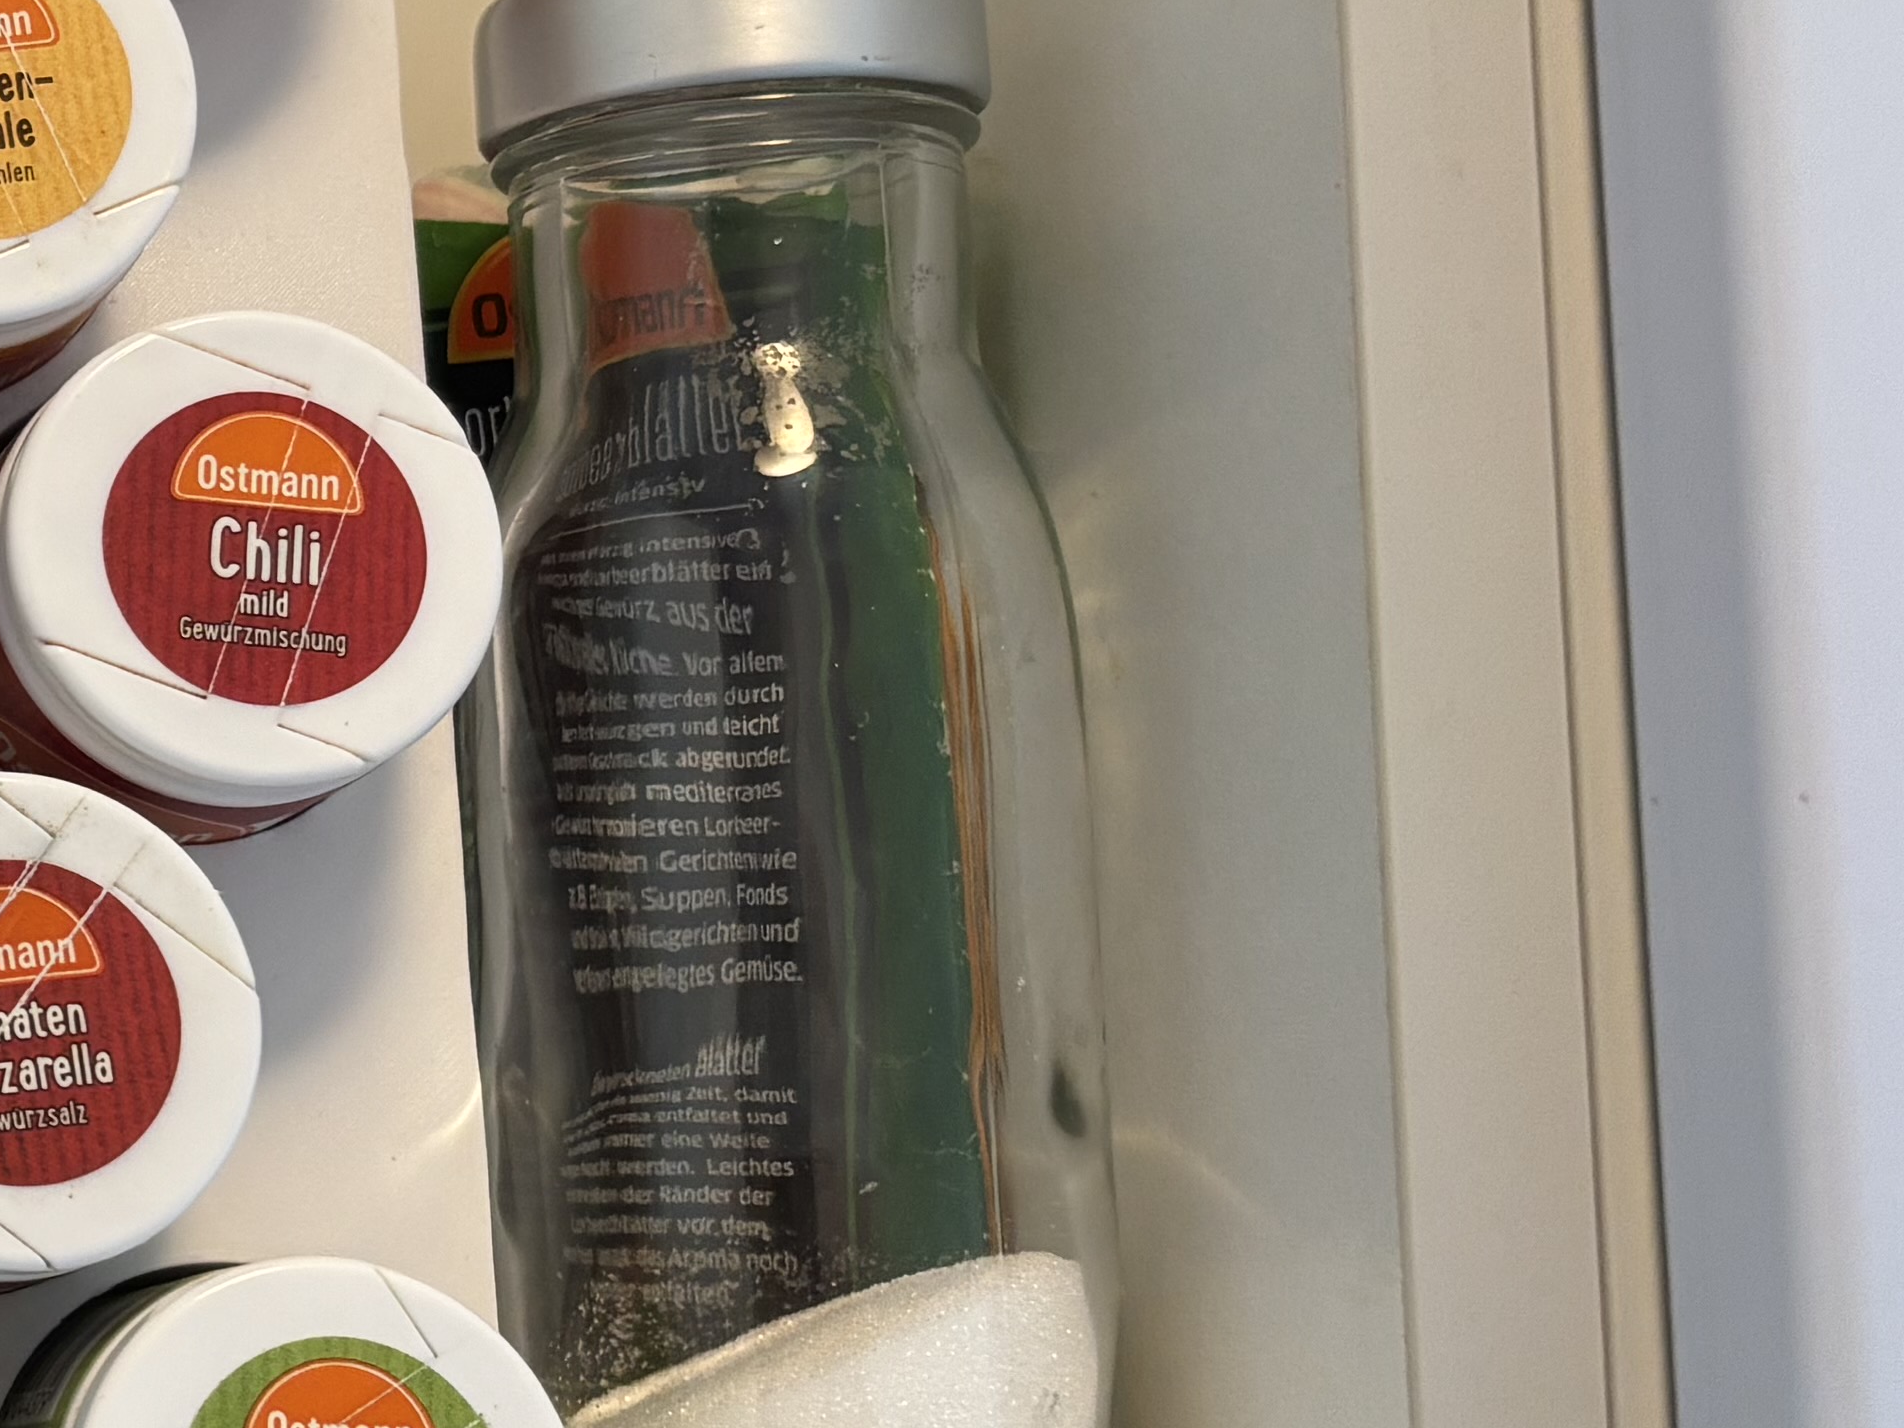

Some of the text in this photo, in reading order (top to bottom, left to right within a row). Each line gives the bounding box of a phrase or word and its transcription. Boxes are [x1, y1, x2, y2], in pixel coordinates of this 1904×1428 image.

[197, 454, 340, 501] Ostmann
[210, 516, 321, 585] Chili
[240, 590, 288, 618] mild
[180, 616, 347, 657] Gewürzmischung
[725, 683, 784, 706] durch
[737, 883, 788, 906] Fonds
[706, 1158, 794, 1176] Leichtes
